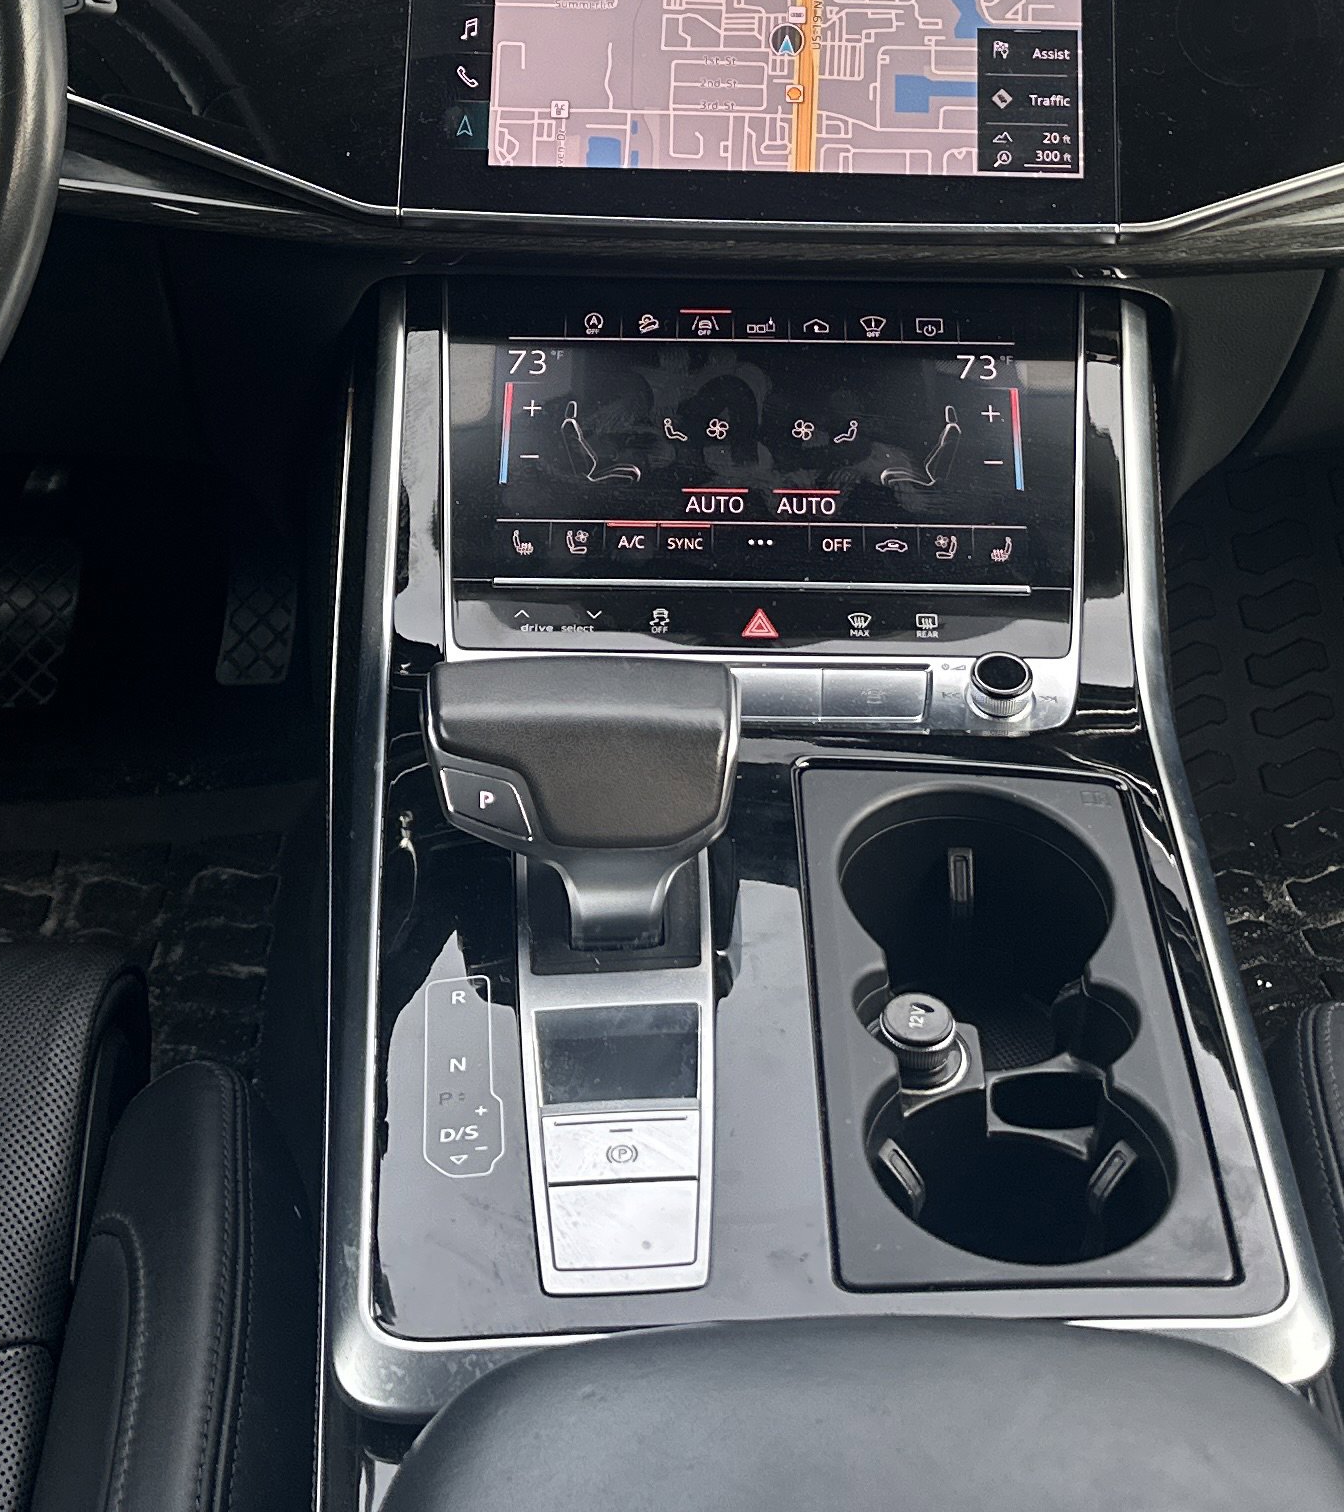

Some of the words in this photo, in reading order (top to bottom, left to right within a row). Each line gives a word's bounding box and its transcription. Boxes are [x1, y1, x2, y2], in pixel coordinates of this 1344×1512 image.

[811, 15, 822, 50] US-19
[1032, 48, 1070, 60] Assist
[704, 56, 720, 65] 1st
[725, 56, 737, 66] St
[700, 79, 720, 88] 2nd
[726, 79, 738, 88] St
[700, 102, 718, 111] 3rd
[724, 102, 736, 111] St
[1029, 94, 1070, 107] Traffic
[1042, 132, 1060, 144] 20
[1062, 134, 1071, 144] ft
[1035, 151, 1060, 162] 300
[1063, 152, 1071, 162] ft
[508, 349, 547, 375] 73
[956, 354, 997, 380] 73
[685, 496, 744, 514] AUTO
[776, 497, 836, 515] AUTO
[617, 535, 645, 549] A/C
[667, 537, 703, 550] SYNC
[822, 539, 852, 552] OFF
[520, 623, 554, 633] drive
[560, 623, 595, 633] select
[650, 626, 669, 634] OFF
[849, 628, 870, 637] MAX
[915, 629, 939, 638] REAR
[479, 790, 494, 809] P
[451, 990, 466, 1005] R
[908, 1004, 926, 1029] 12V
[449, 1057, 466, 1072] N
[439, 1125, 479, 1143] D/S
